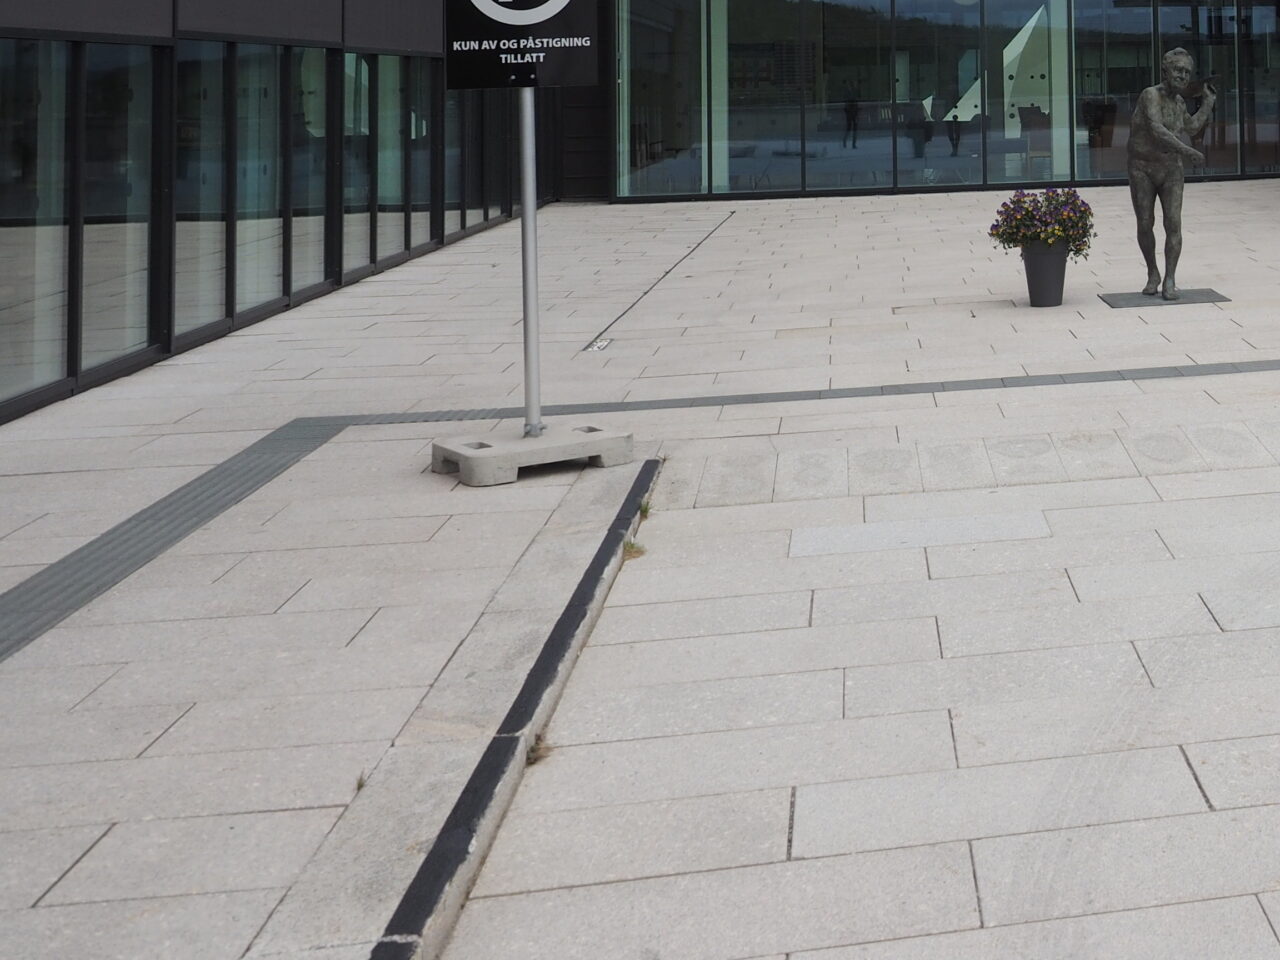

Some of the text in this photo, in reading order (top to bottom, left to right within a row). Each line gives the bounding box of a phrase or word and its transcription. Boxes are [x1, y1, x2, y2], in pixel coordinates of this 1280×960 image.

[453, 36, 591, 51] KUN AV OG PÅSTIGNING
[499, 52, 546, 64] TILLATT
